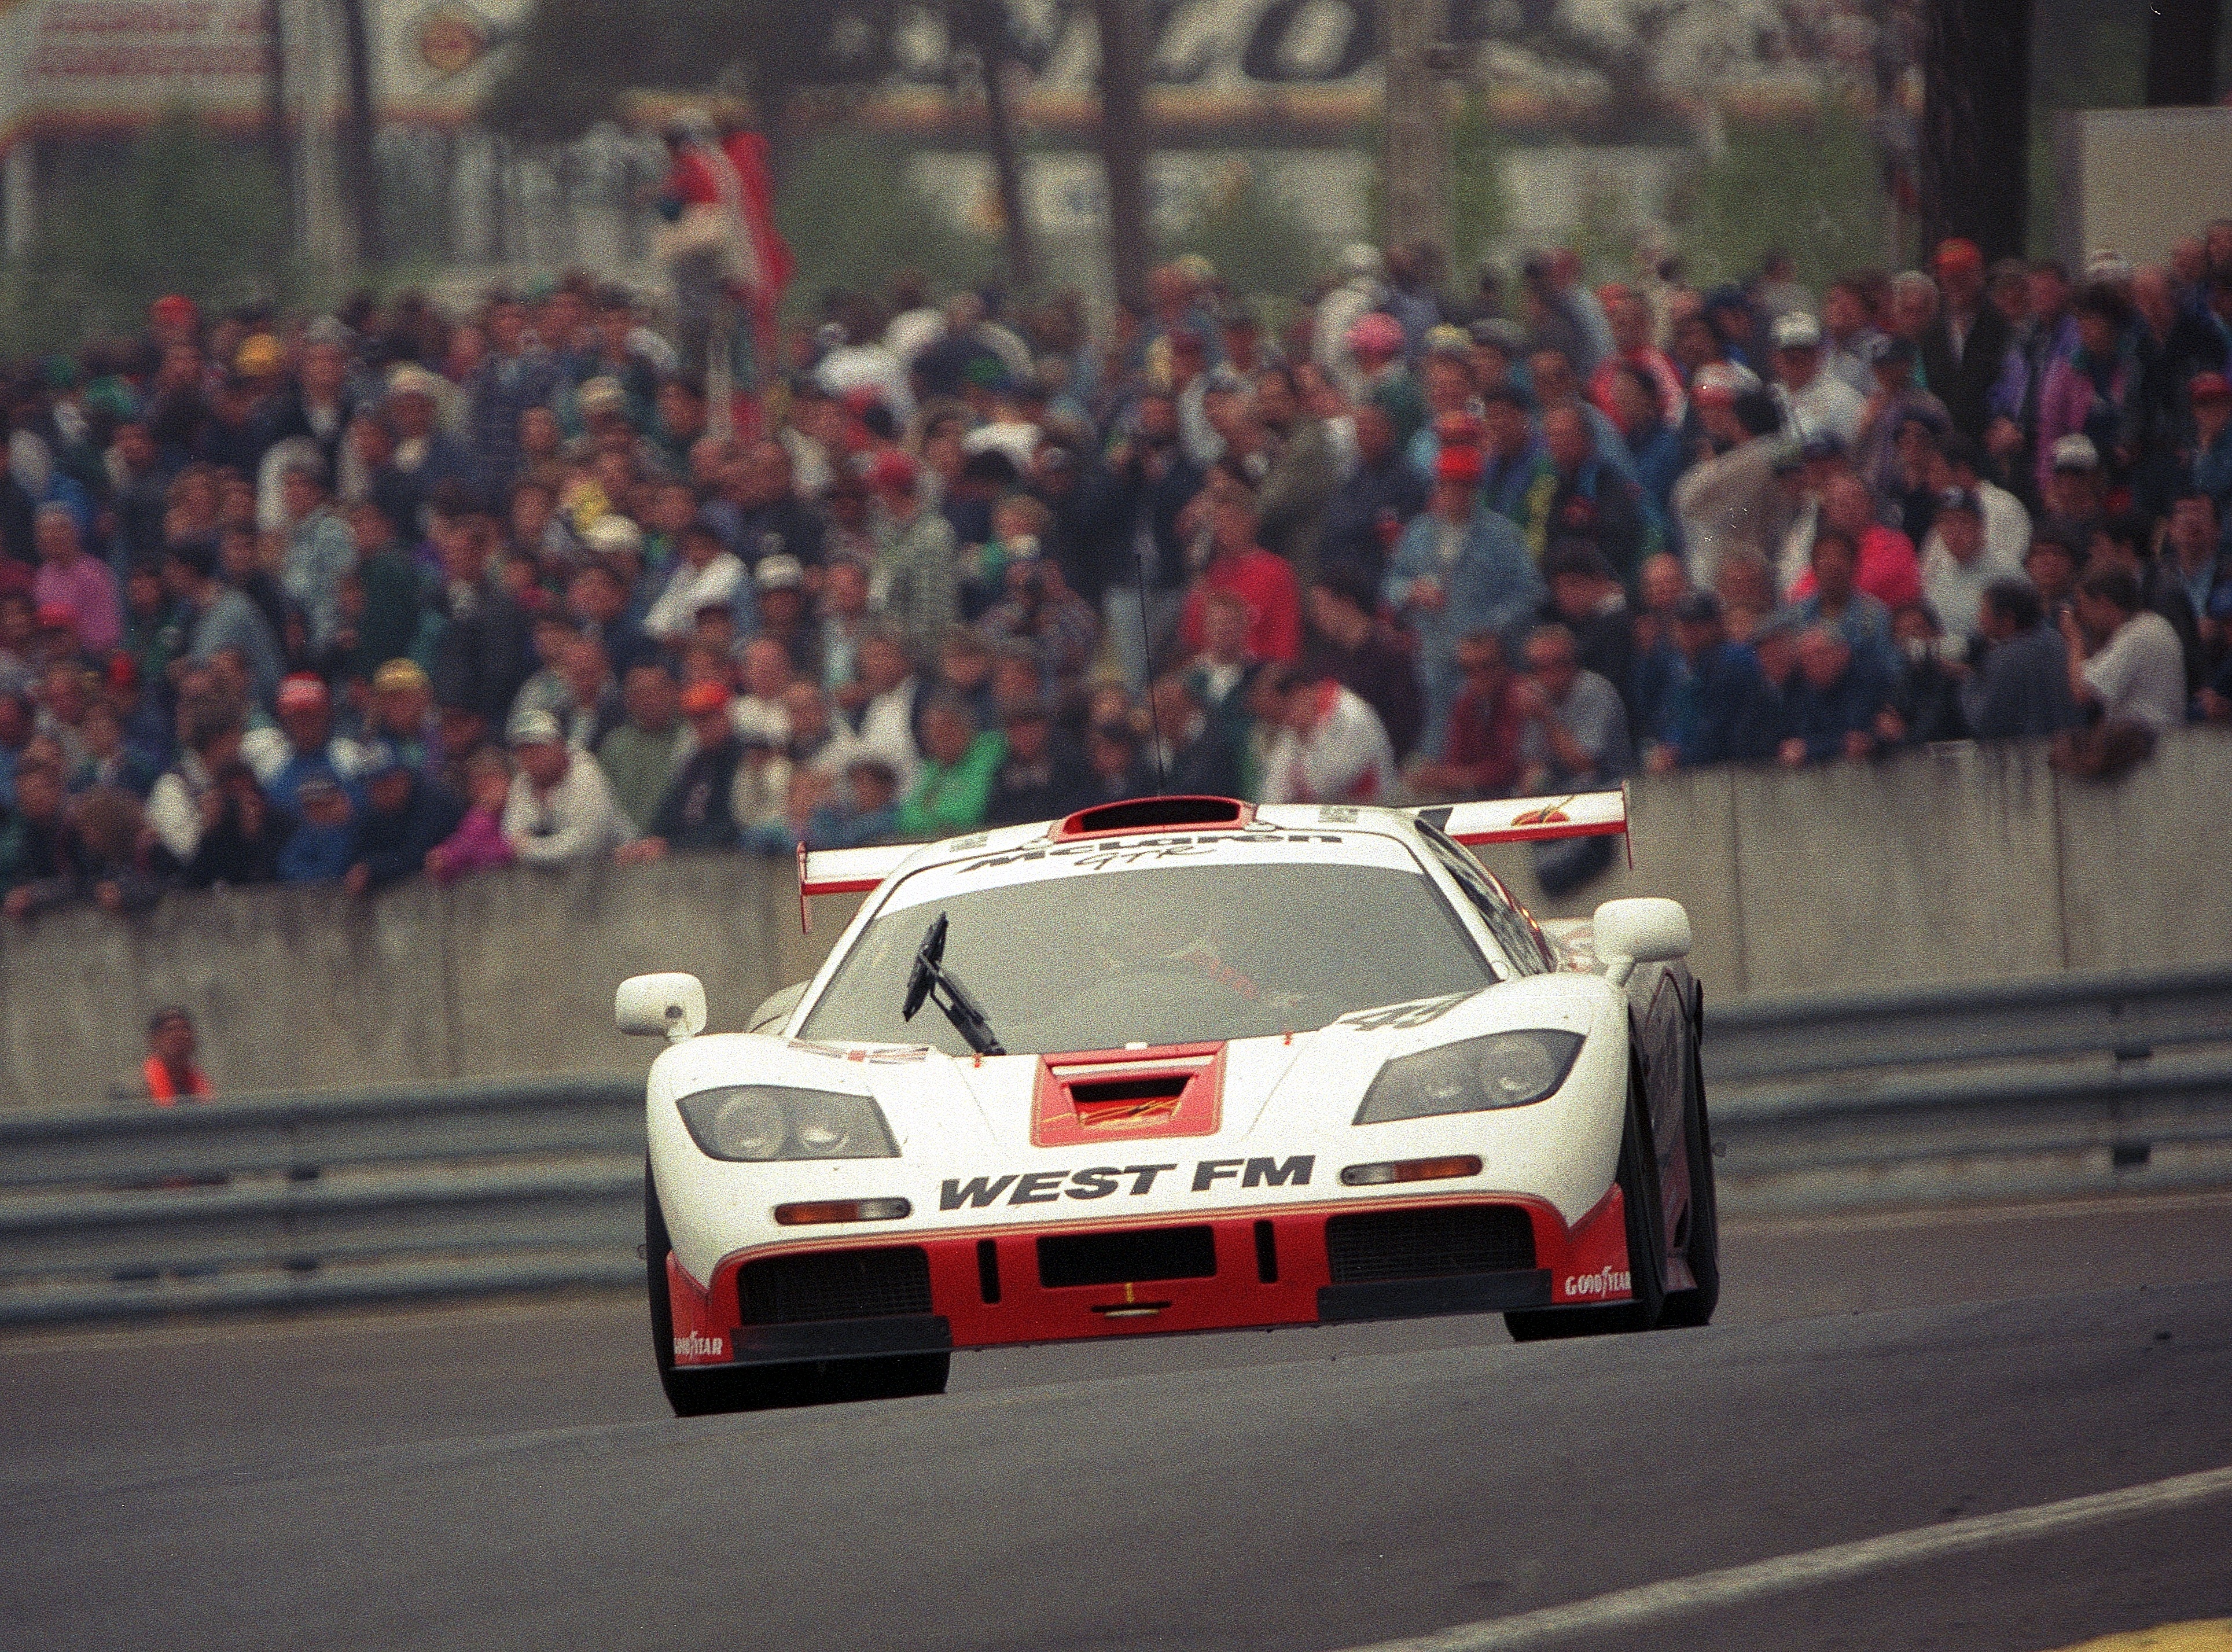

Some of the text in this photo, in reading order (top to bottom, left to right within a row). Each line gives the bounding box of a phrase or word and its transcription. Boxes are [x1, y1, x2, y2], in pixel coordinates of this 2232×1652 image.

[956, 835, 1343, 873] McLaren
[939, 1155, 1315, 1211] WEST FM
